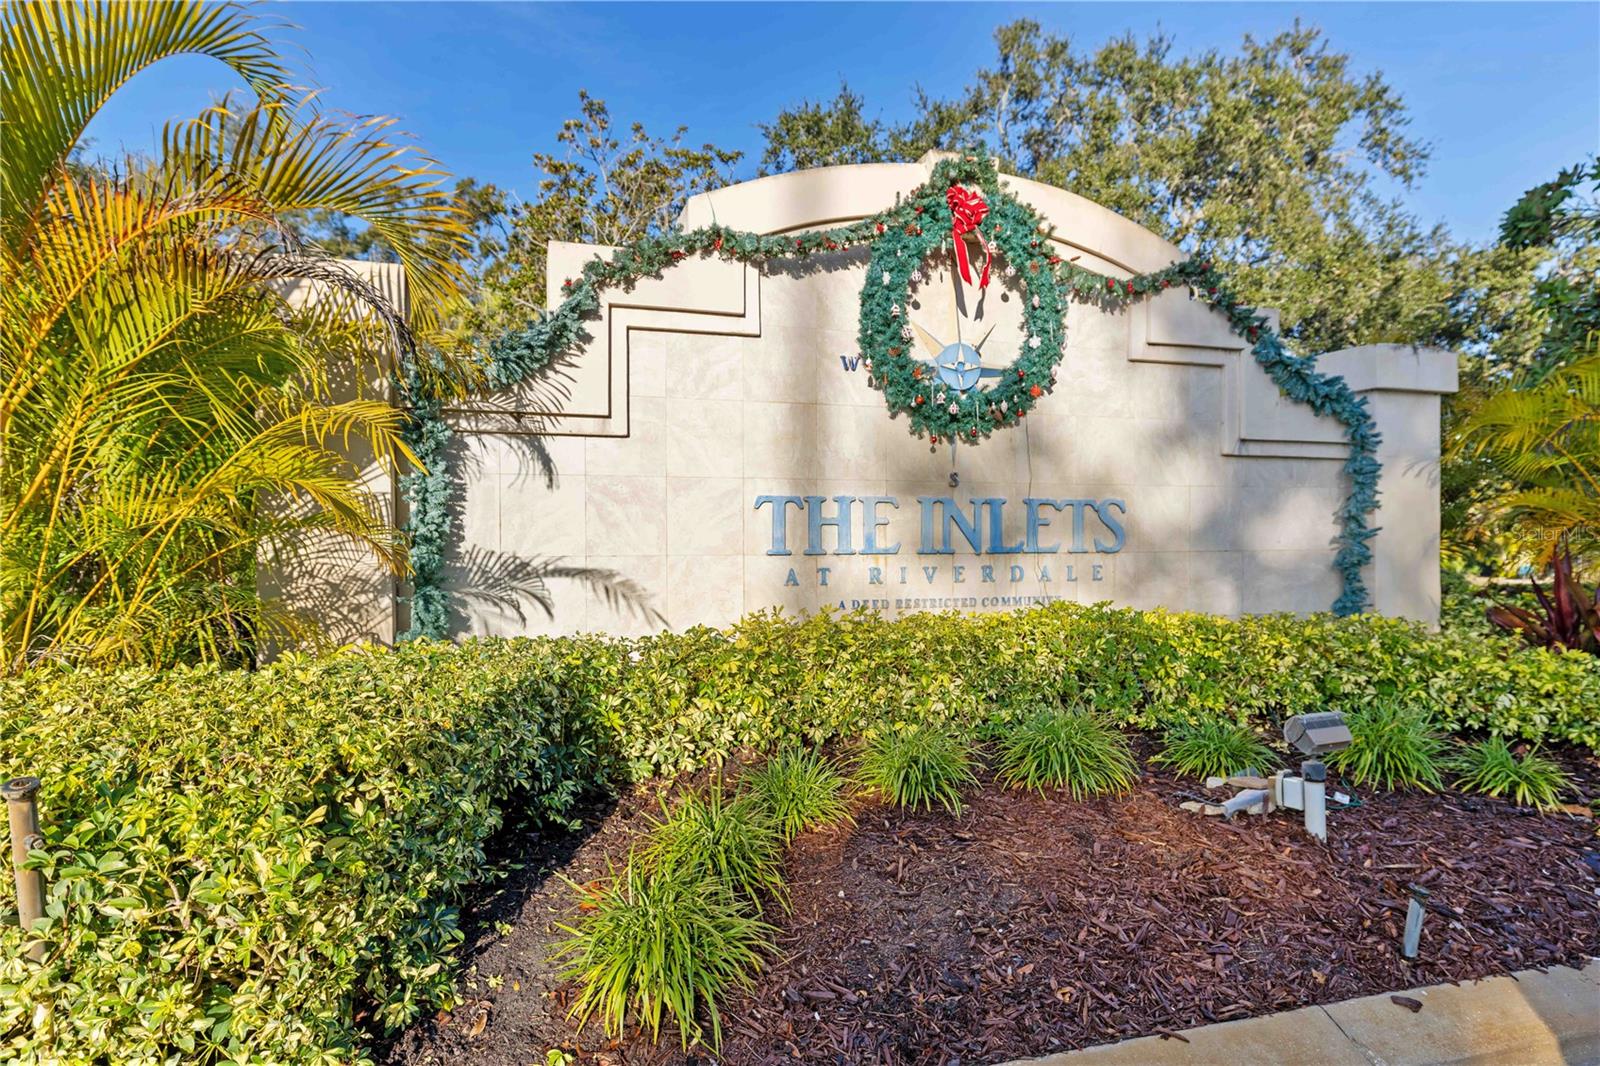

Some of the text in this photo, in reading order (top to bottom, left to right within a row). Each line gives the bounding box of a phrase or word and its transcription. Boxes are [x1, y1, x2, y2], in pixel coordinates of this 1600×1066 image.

[840, 354, 862, 371] W
[949, 471, 960, 488] S
[754, 495, 1127, 556] THE INLETS
[784, 564, 1104, 586] AT RIVERDALE
[839, 600, 846, 610] A
[895, 598, 977, 609] RESTRICTED
[981, 595, 1062, 608] COMMUNIT
